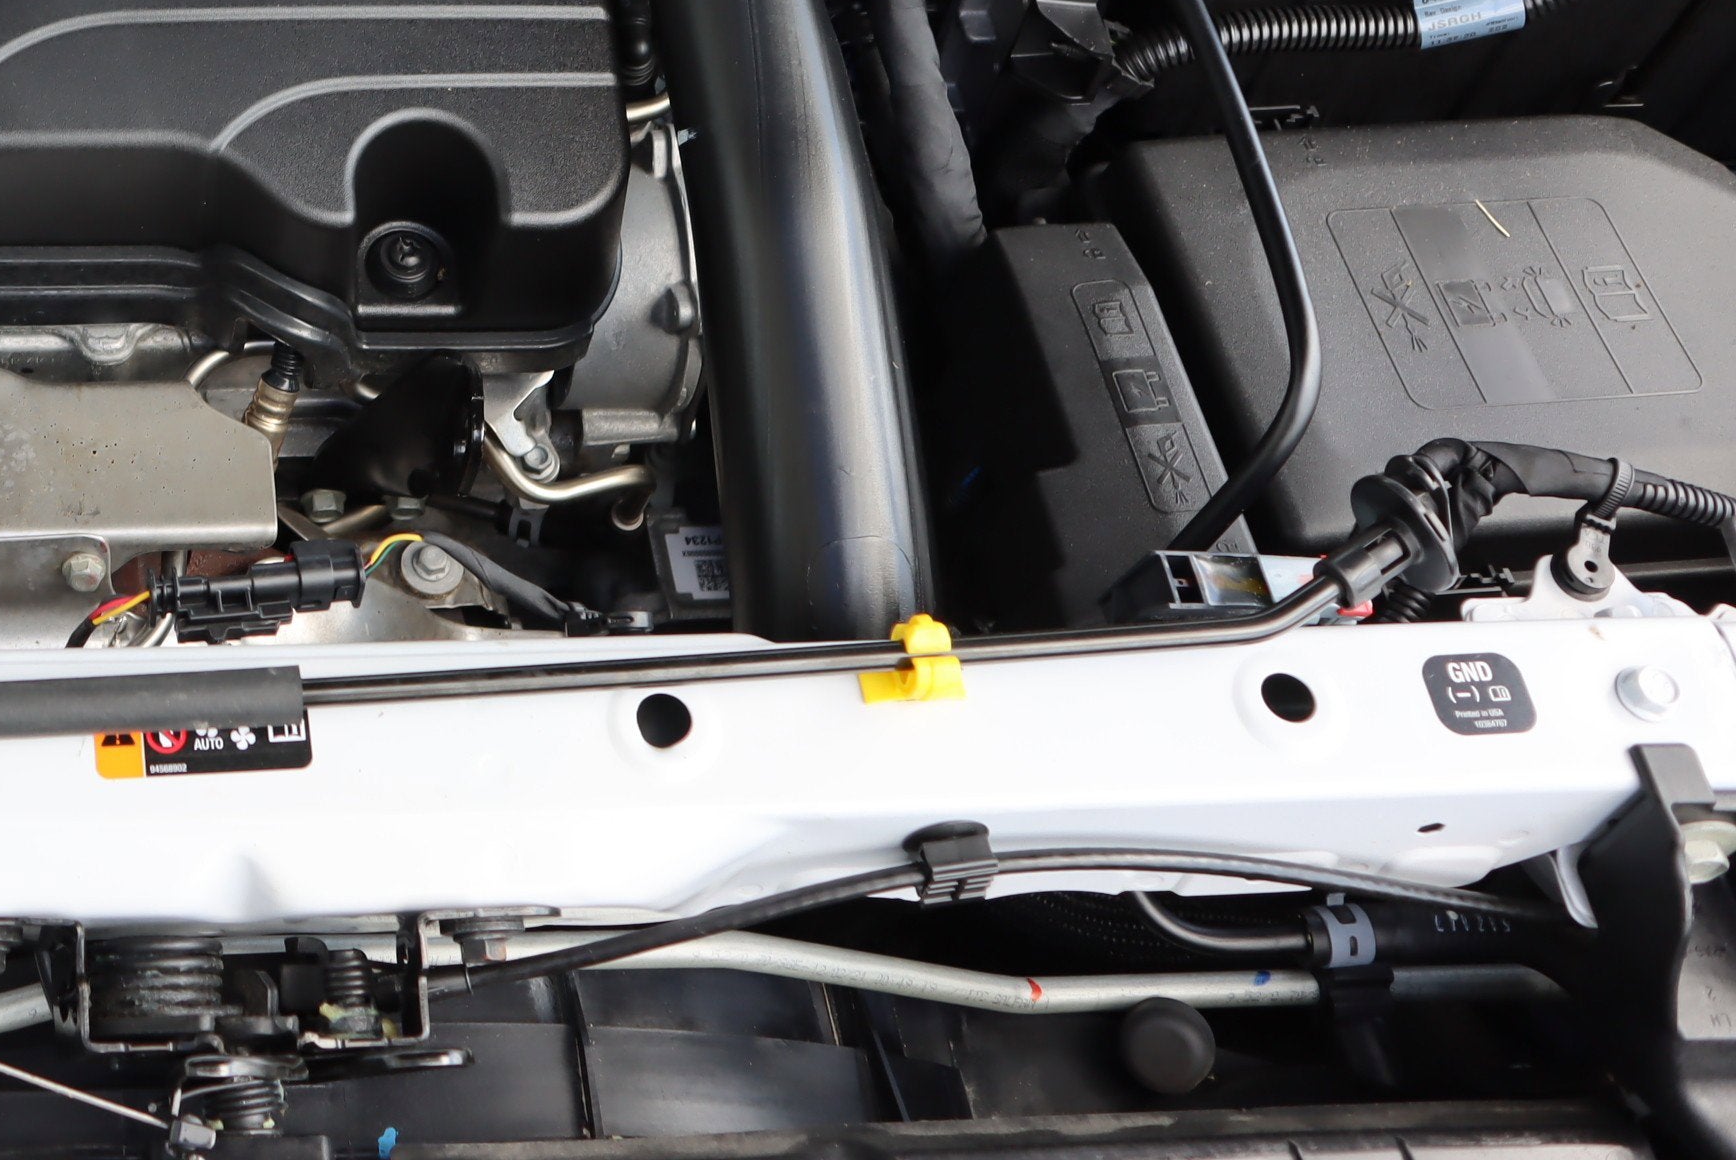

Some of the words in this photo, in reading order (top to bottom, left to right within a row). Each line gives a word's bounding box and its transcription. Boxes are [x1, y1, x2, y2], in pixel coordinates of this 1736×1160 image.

[1447, 660, 1493, 683] GND
[1488, 707, 1505, 717] USA
[193, 736, 225, 751] AUTO
